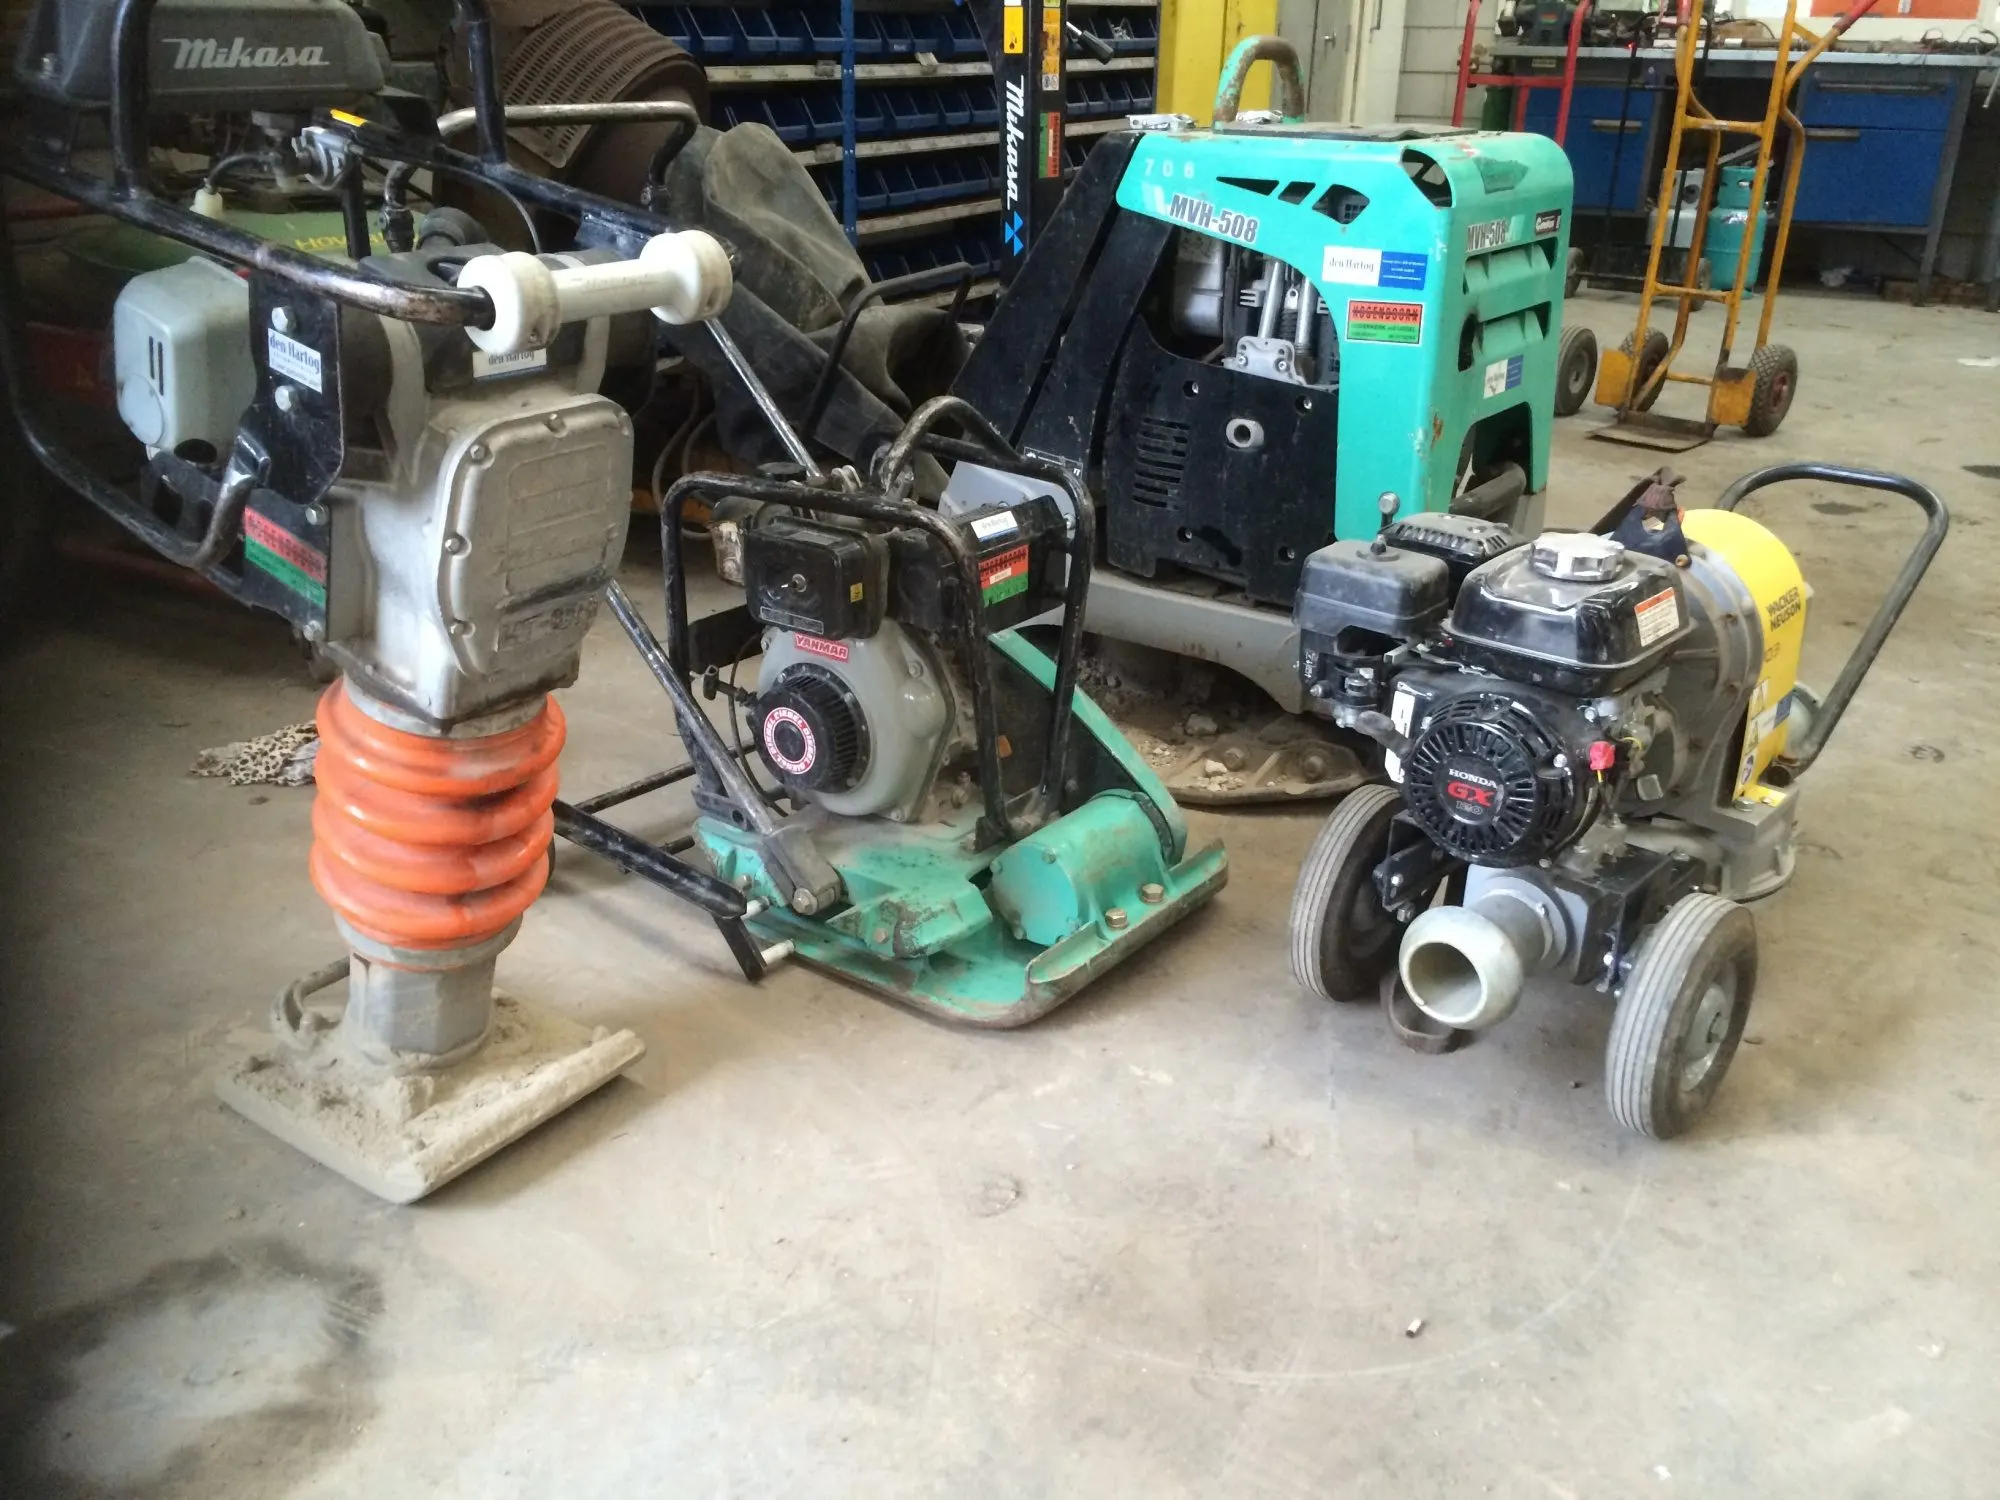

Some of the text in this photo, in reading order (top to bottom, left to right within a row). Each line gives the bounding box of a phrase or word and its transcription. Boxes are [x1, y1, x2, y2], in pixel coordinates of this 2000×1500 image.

[161, 37, 330, 69] Mikasa
[1006, 75, 1025, 210] Mikasa
[1169, 194, 1258, 243] MVH-508
[1468, 218, 1506, 252] MVH-508
[1766, 586, 1800, 616] WACKER
[1770, 602, 1801, 632] NEUSON
[796, 635, 848, 660] YANMAR
[1448, 768, 1498, 789] HONDA
[1447, 781, 1497, 808] GX
